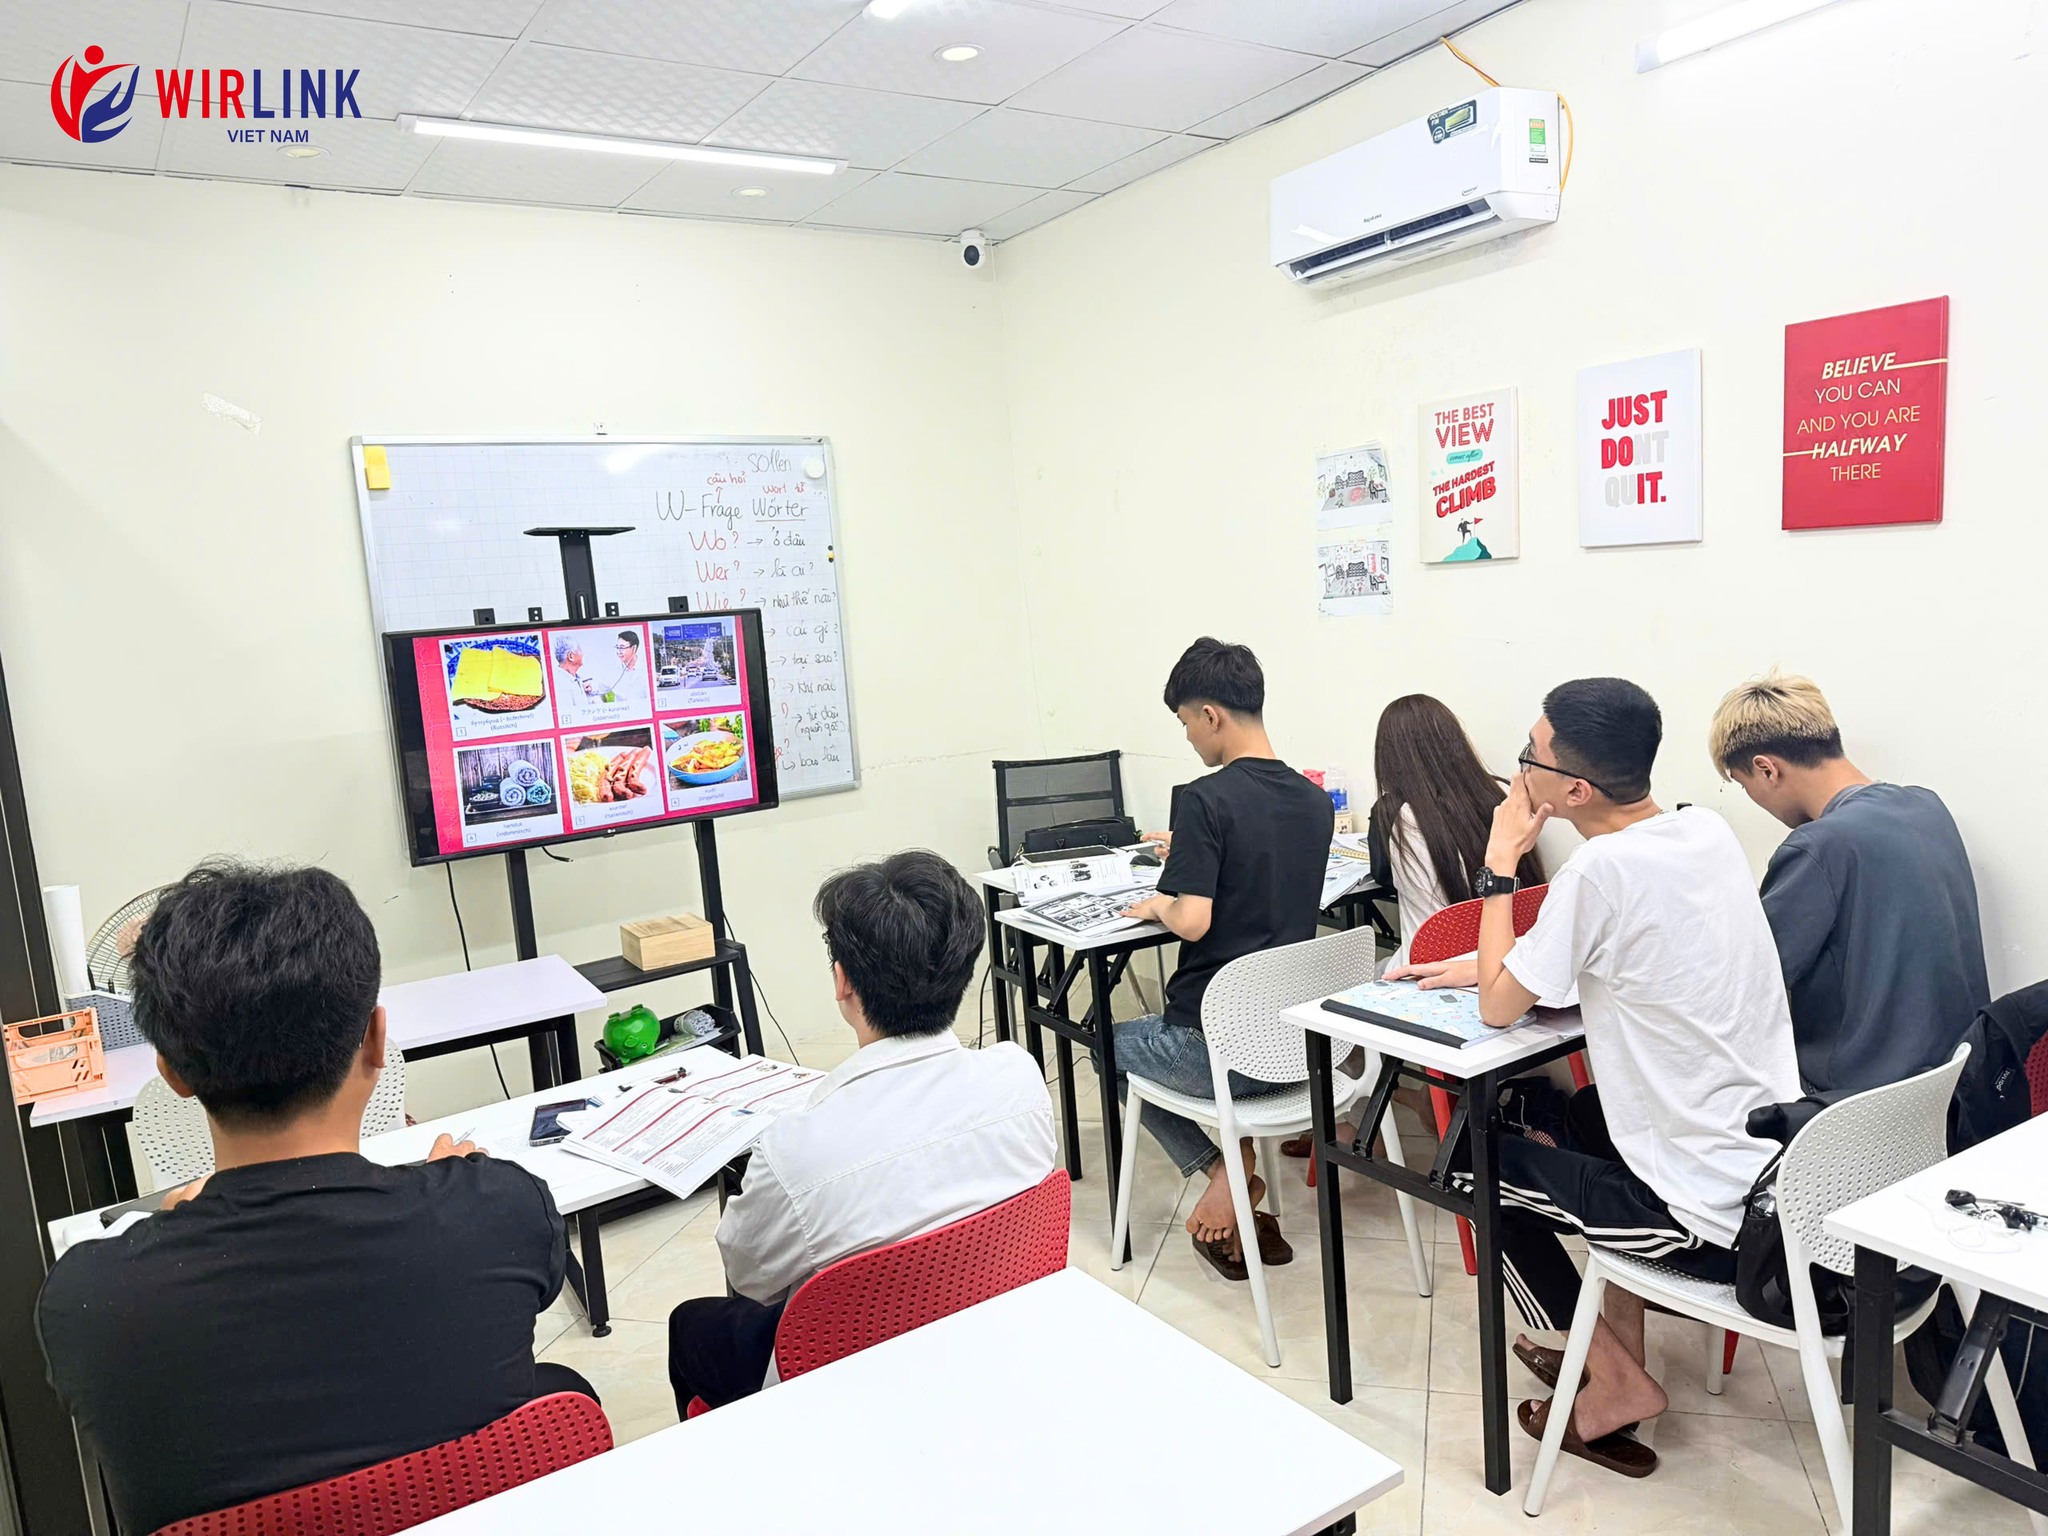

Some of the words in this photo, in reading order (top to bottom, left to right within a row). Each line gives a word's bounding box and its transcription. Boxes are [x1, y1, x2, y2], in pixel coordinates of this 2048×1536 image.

[1821, 352, 1897, 380] BELIEVE
[1815, 384, 1853, 404] YOU
[1857, 378, 1901, 399] CAN
[1434, 409, 1460, 426] THE
[1463, 402, 1495, 421] BEST
[1601, 389, 1668, 430] JUST
[1796, 416, 1836, 435] AND
[1840, 410, 1879, 430] YOU
[1884, 405, 1921, 424] ARE
[1435, 418, 1495, 449] VIEW
[1811, 433, 1908, 460] HALFWAY
[1601, 430, 1669, 470] DONT
[1432, 480, 1451, 497] THE
[1451, 460, 1496, 489] HARDEST
[1830, 462, 1882, 482] THERE
[1436, 476, 1497, 518] CLIMB
[1604, 470, 1667, 508] QUIT.
